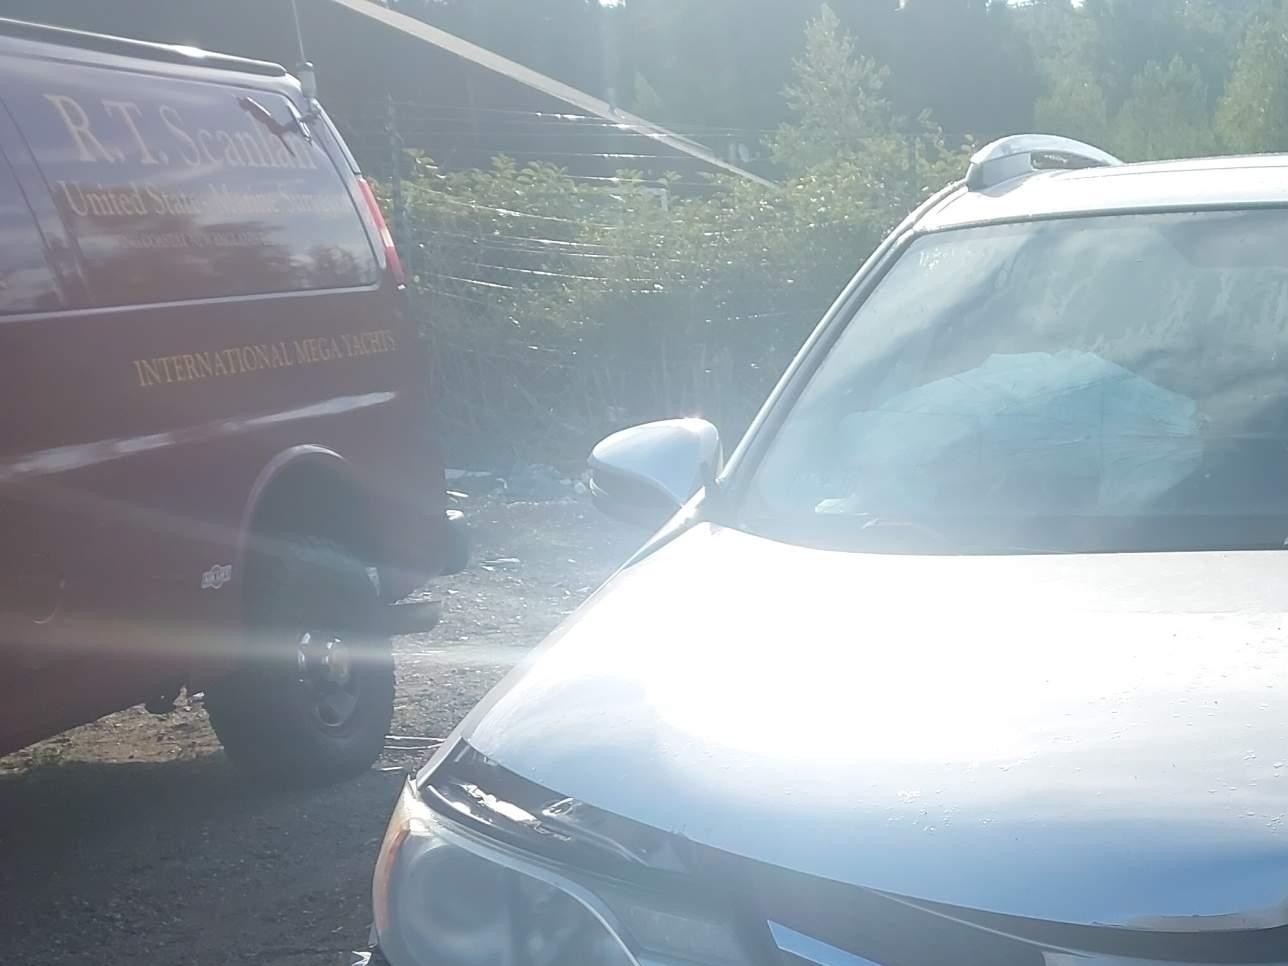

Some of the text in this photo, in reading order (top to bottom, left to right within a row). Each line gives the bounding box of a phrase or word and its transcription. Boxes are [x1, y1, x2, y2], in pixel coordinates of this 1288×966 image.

[57, 181, 149, 216] United
[133, 330, 397, 387] INTERNATIONAL MEGA YACHTS
